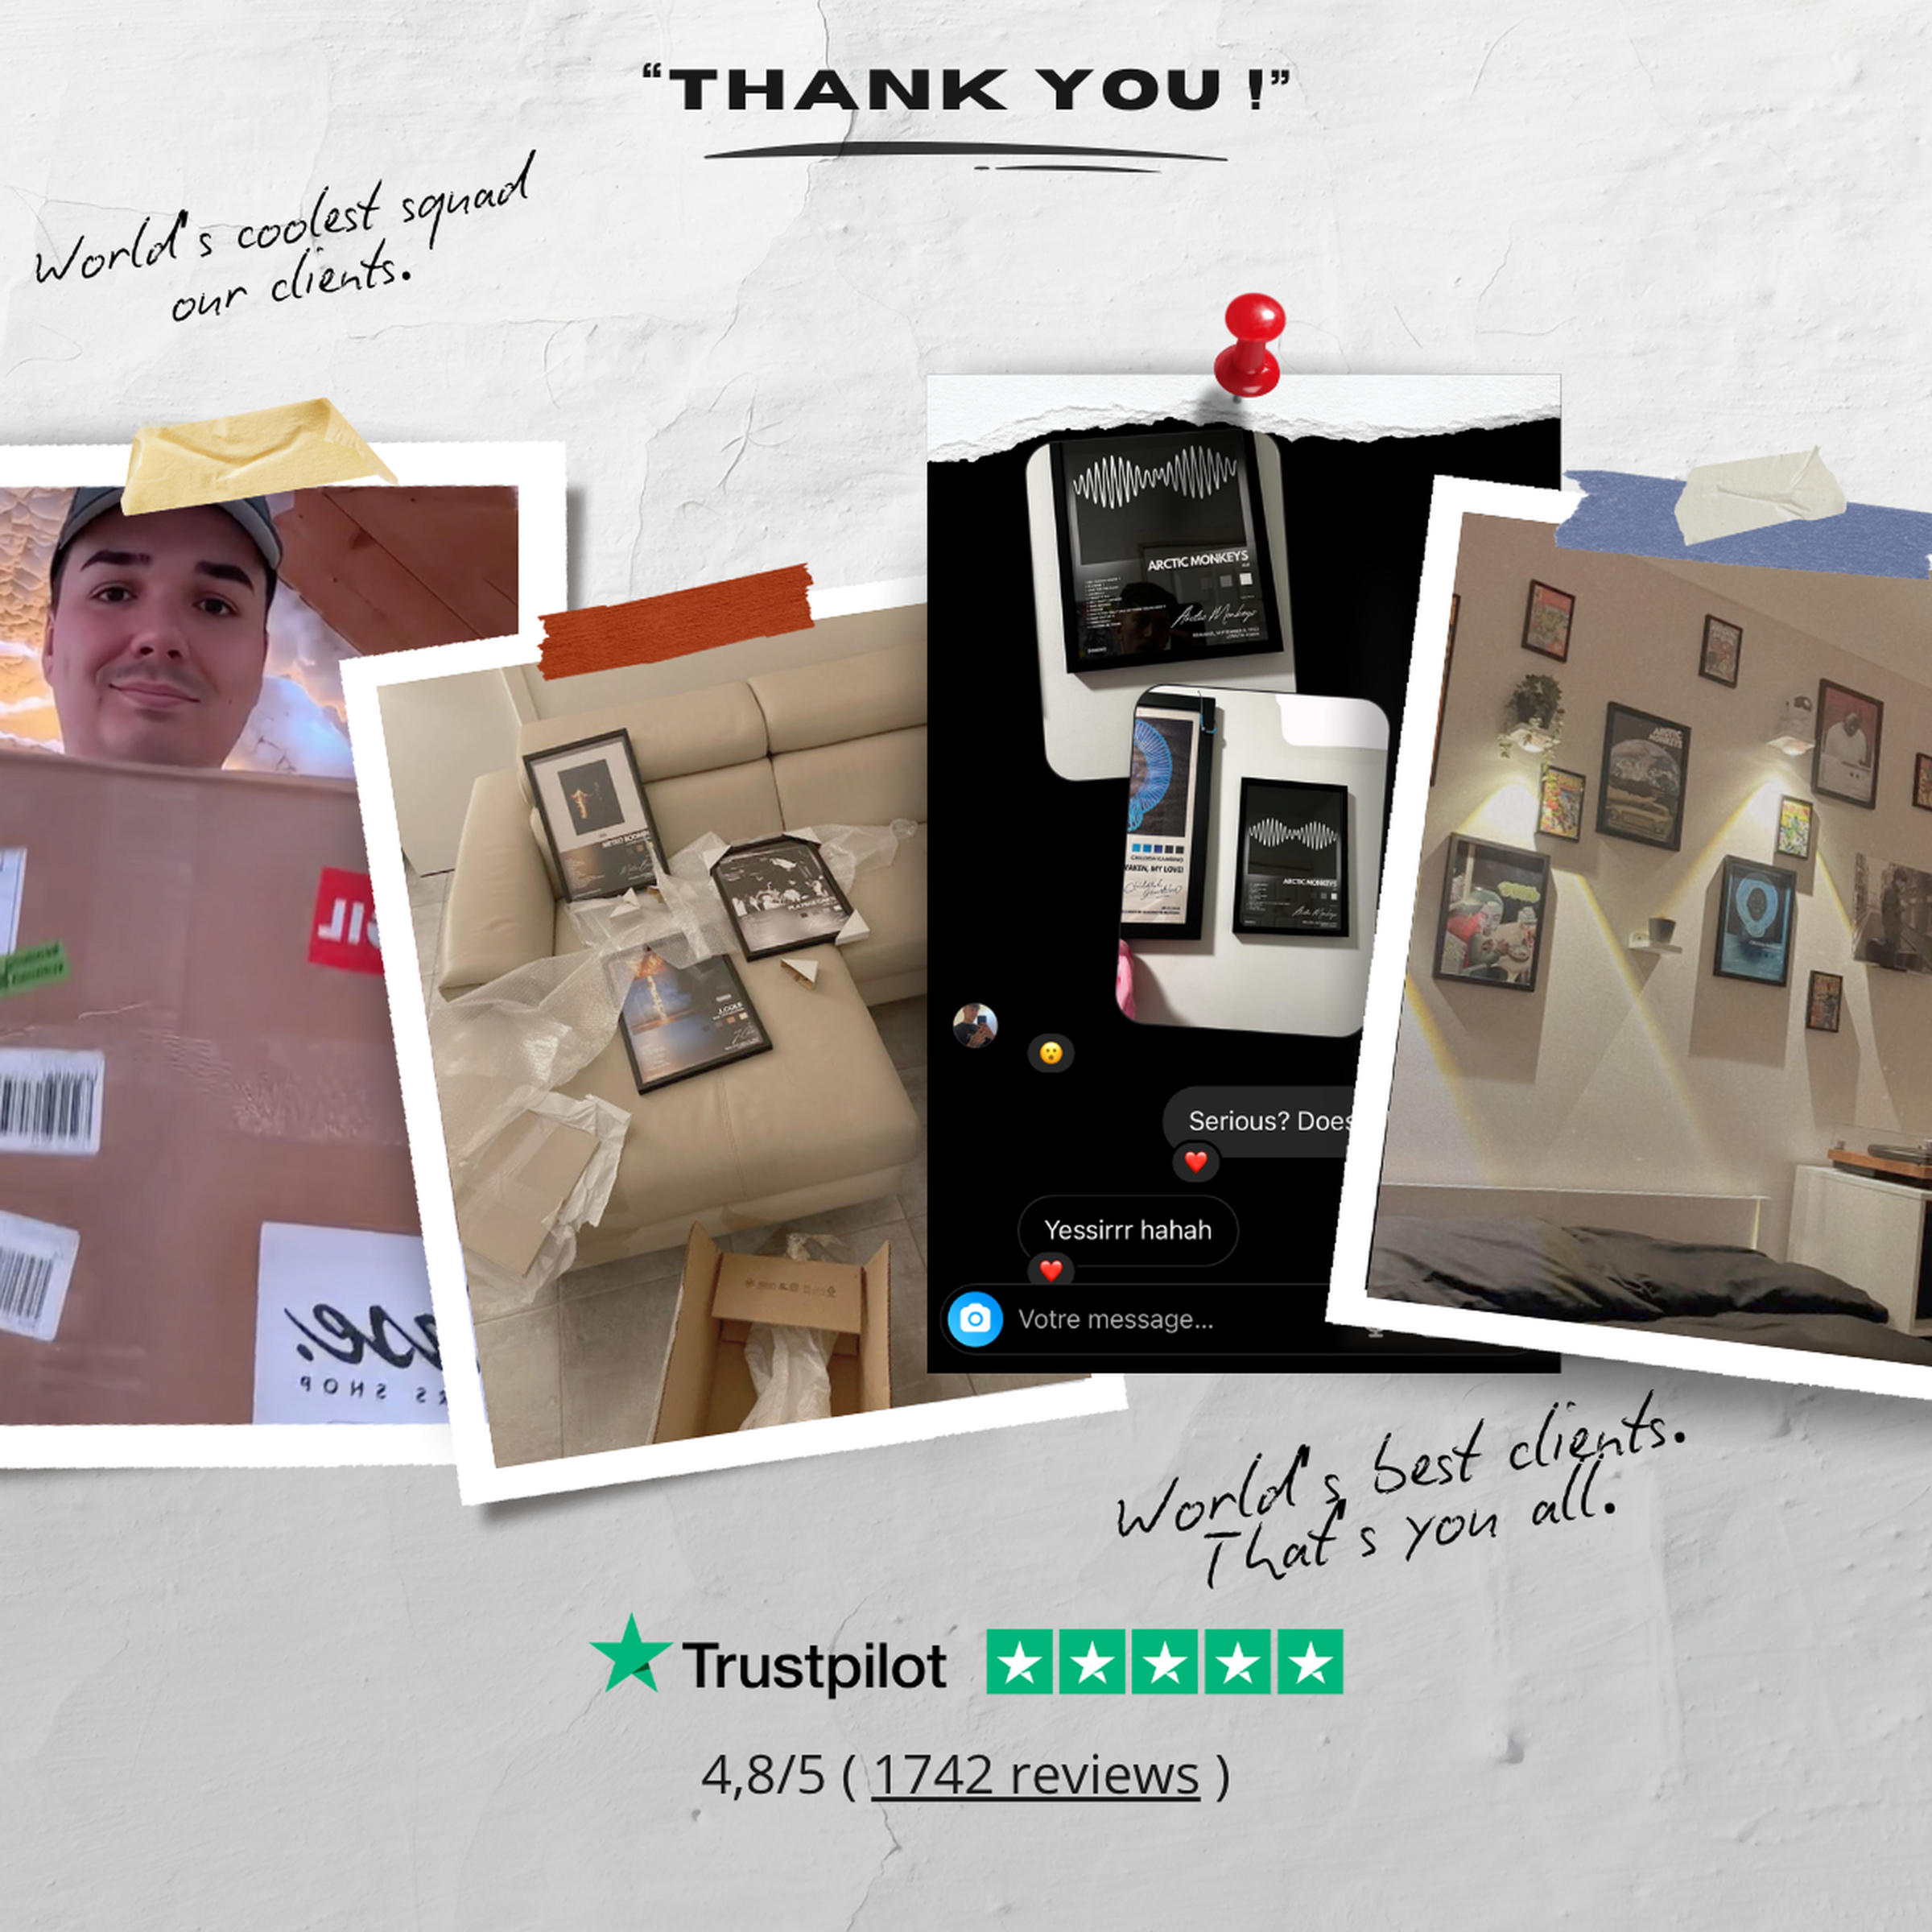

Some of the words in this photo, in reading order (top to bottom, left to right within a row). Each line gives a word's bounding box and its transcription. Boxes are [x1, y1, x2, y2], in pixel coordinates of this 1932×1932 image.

[237, 179, 383, 250] coolest
[402, 148, 538, 251] squad
[171, 286, 248, 323] our
[270, 237, 413, 303] clients.
[1147, 555, 1189, 572] ARCTIC
[1190, 550, 1249, 568] MONKEYS
[1189, 1110, 1290, 1131] Serious?
[1044, 1219, 1133, 1241] Yessirrr
[1141, 1219, 1212, 1241] hahah
[1018, 1309, 1080, 1329] Votre
[1373, 1417, 1485, 1496] best
[1509, 1388, 1687, 1472] clients.
[1405, 1511, 1498, 1563] you
[1531, 1452, 1618, 1525] all.
